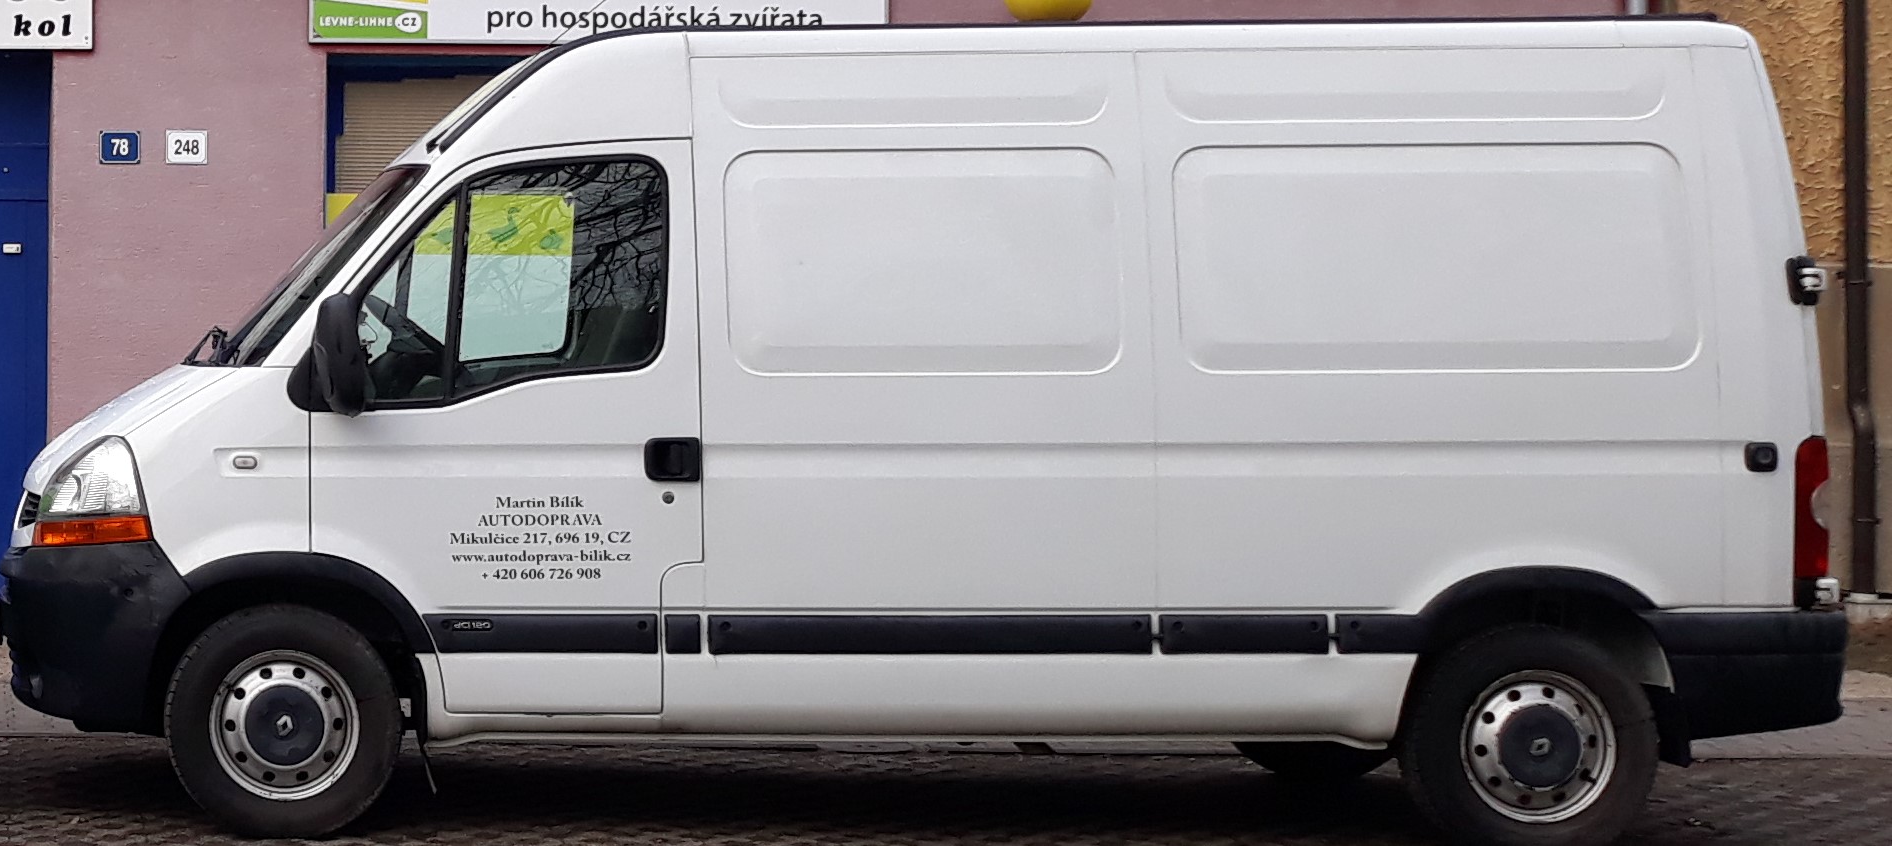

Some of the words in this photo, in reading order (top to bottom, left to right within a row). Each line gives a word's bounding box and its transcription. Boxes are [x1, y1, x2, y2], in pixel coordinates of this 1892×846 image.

[13, 14, 72, 37] kol
[486, 10, 533, 34] pro
[542, 4, 721, 35] hospodářská
[729, 6, 823, 27] zvířata
[110, 138, 129, 156] 78
[174, 139, 200, 155] 248
[495, 496, 545, 509] Martin
[549, 495, 585, 509] Bílík
[477, 513, 603, 527] AUTODOPRAVA
[449, 531, 520, 545] Mikulčice
[523, 531, 553, 546] 217,
[554, 531, 581, 545] 696
[584, 531, 605, 546] 19,
[607, 531, 632, 544] CZ
[451, 549, 632, 566] www.autodoprava-bilik.cz
[492, 568, 518, 580] 420
[520, 568, 546, 580] 606
[548, 567, 574, 580] 726
[576, 567, 602, 580] 908
